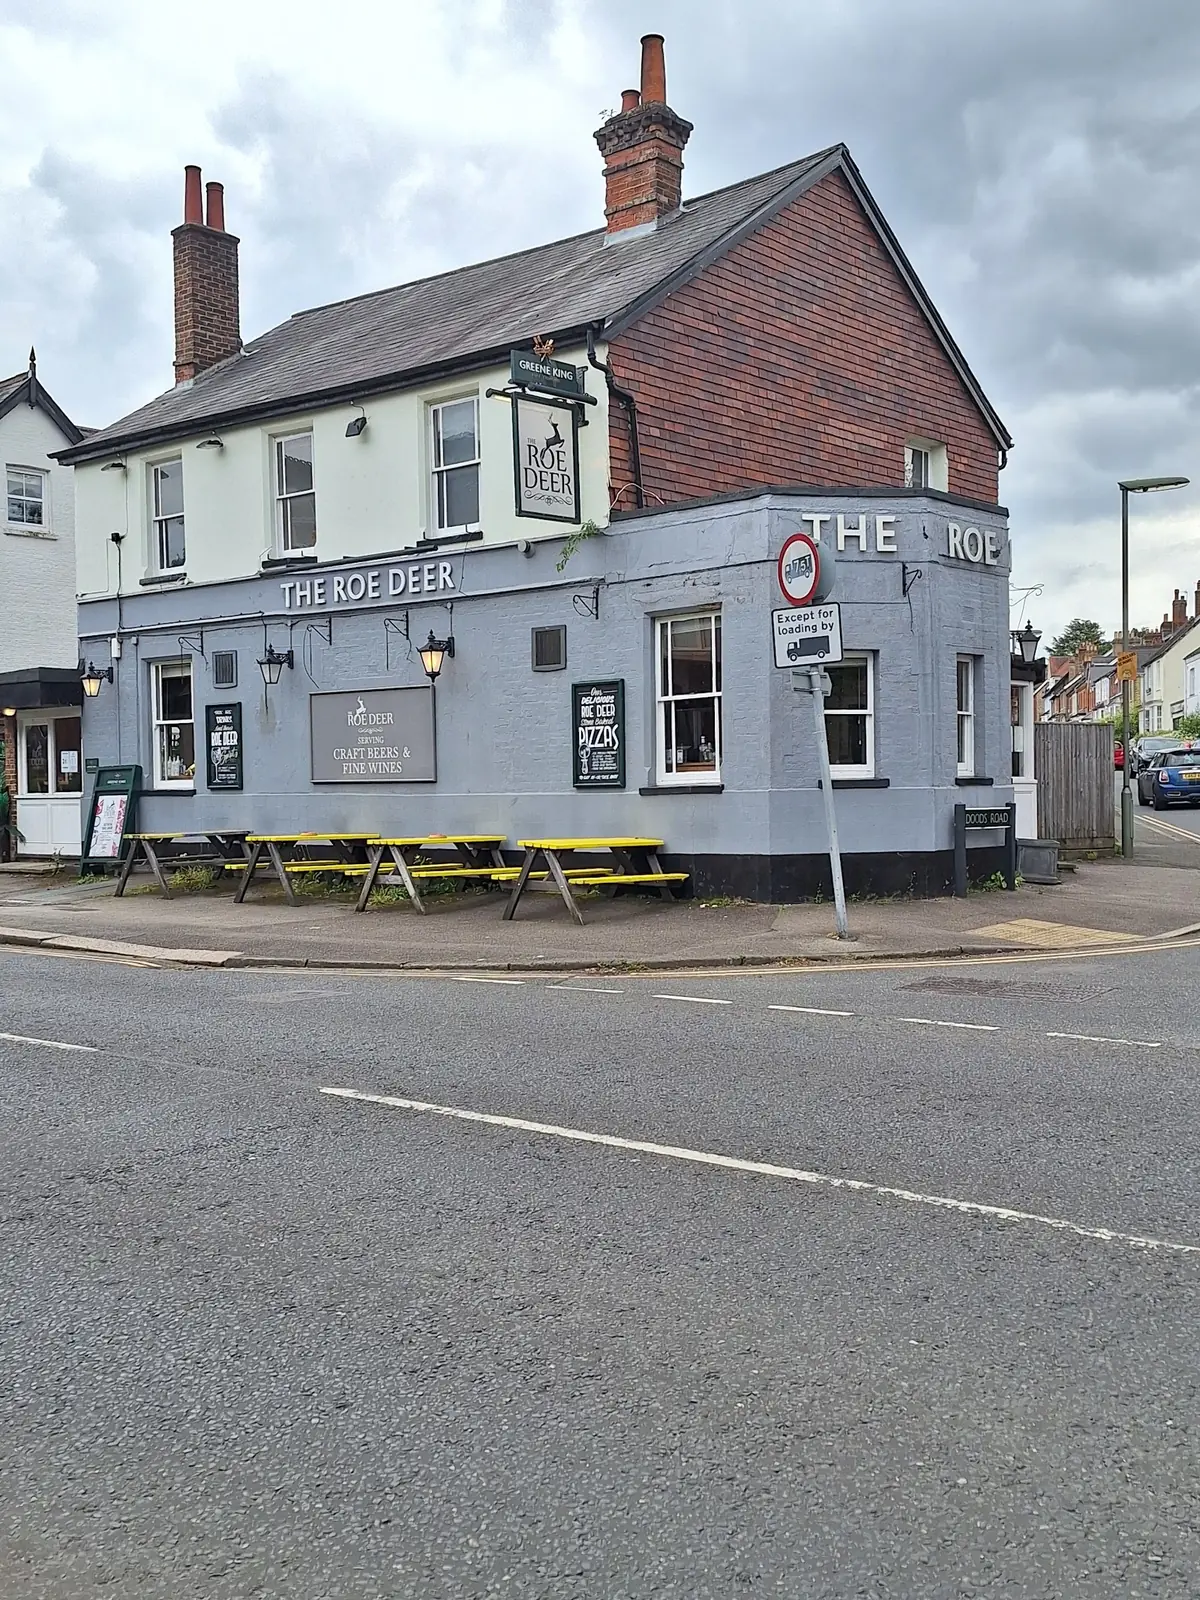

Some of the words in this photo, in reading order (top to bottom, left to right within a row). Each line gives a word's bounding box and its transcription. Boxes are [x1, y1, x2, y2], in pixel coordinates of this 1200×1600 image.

[518, 359, 551, 376] GREENE
[552, 367, 574, 382] KING
[526, 444, 567, 472] ROE
[523, 467, 573, 496] DEER
[801, 512, 898, 552] THE
[947, 522, 998, 565] ROE
[280, 578, 326, 608] THE
[333, 571, 380, 603] ROE
[388, 561, 454, 596] DEER
[777, 611, 815, 624] Except
[818, 609, 834, 619] for
[778, 623, 818, 636] loading
[821, 620, 834, 632] by
[581, 695, 615, 705] DELICIOUS
[581, 705, 594, 718] ROE
[596, 704, 616, 717] DEER
[347, 713, 368, 726] ROE
[368, 712, 394, 725] DEER
[595, 717, 615, 726] Baked
[357, 736, 384, 745] SERVING
[578, 723, 619, 750] PIZZAS
[333, 748, 365, 760] CRAFT
[367, 747, 399, 759] BEERS
[403, 746, 411, 758] &
[342, 762, 367, 775] FINE
[368, 761, 402, 774] WINES
[965, 813, 988, 824] DOODS
[990, 812, 1009, 824] ROAD
